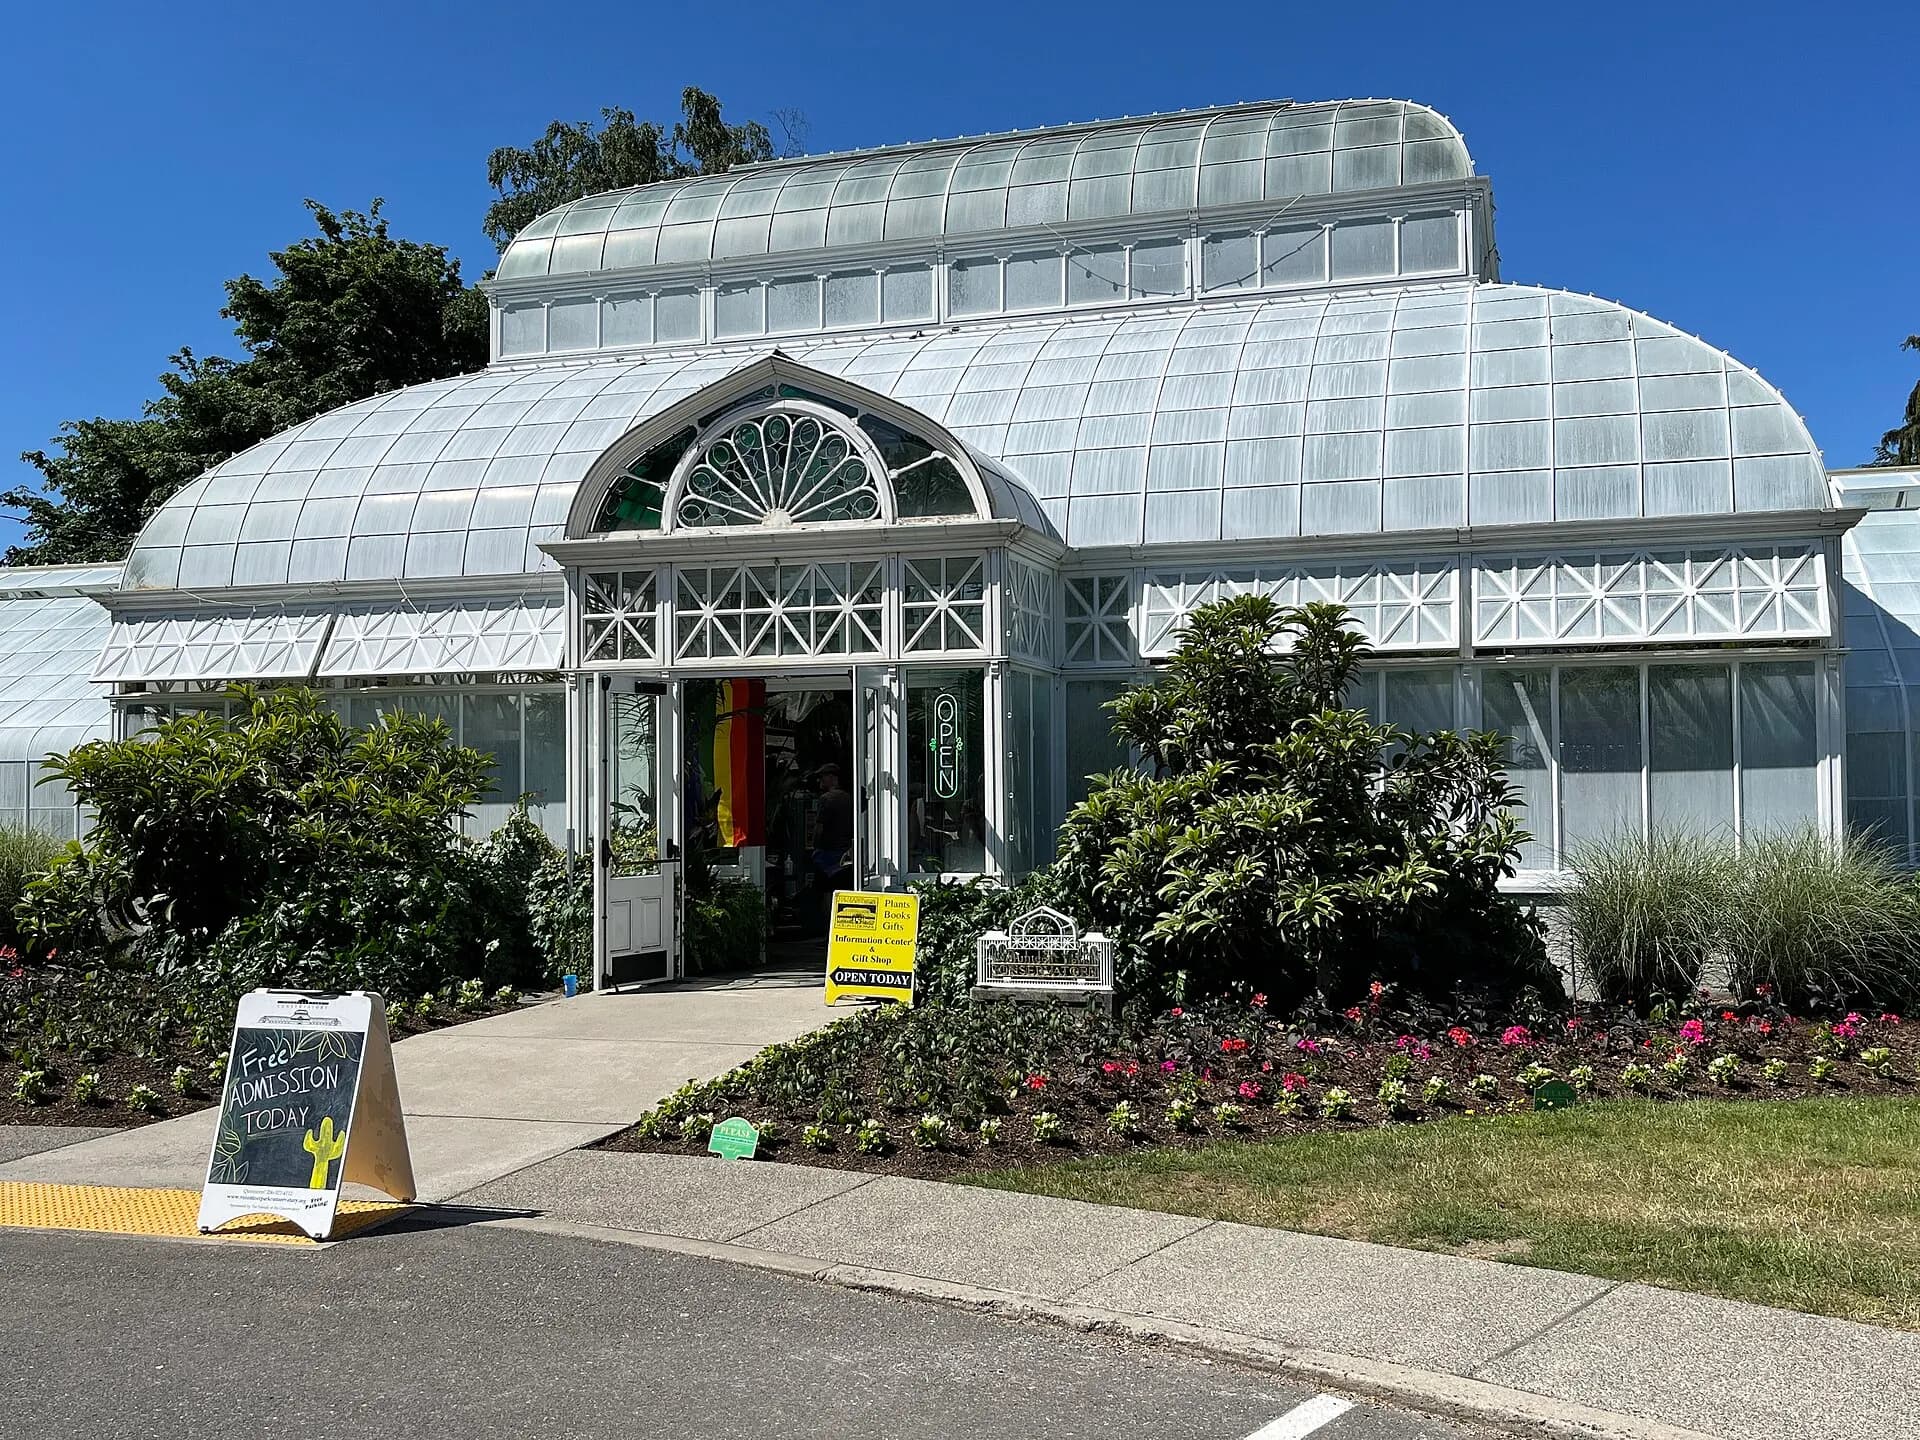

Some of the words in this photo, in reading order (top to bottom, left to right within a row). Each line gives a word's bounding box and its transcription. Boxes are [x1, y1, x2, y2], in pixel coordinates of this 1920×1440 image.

[938, 701, 954, 791] OPEN
[885, 899, 911, 909] Plants
[884, 911, 911, 920] Books
[882, 921, 904, 931] Gifts
[835, 934, 883, 945] Information
[884, 937, 913, 946] Center
[851, 954, 868, 963] Gift
[870, 955, 892, 965] Shop
[835, 971, 867, 983] OPEN
[869, 973, 910, 986] TODAY
[241, 1047, 289, 1077] Free
[229, 1064, 339, 1113] ADMISSION
[240, 1106, 309, 1134] TODAY
[720, 1126, 751, 1138] PLEASE
